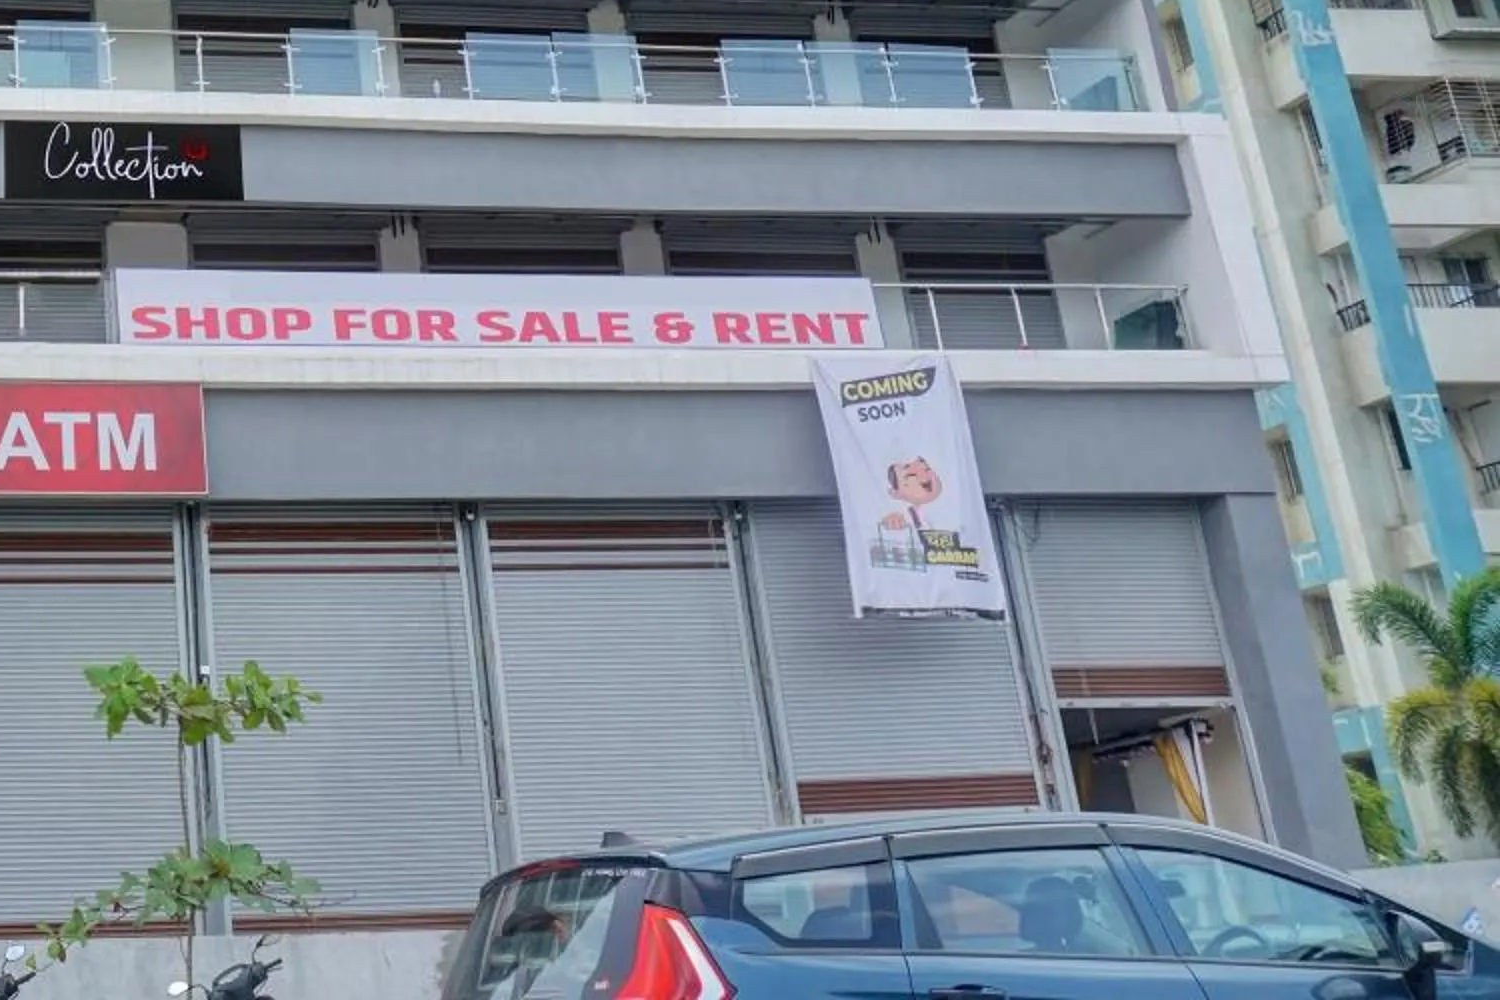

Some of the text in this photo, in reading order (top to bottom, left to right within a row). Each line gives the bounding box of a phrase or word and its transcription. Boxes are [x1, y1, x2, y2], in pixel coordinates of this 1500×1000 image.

[45, 121, 203, 199] Collection
[131, 306, 870, 345] SHOP FOR SALE & RENT
[843, 371, 929, 400] COMING
[857, 402, 906, 422] SOON
